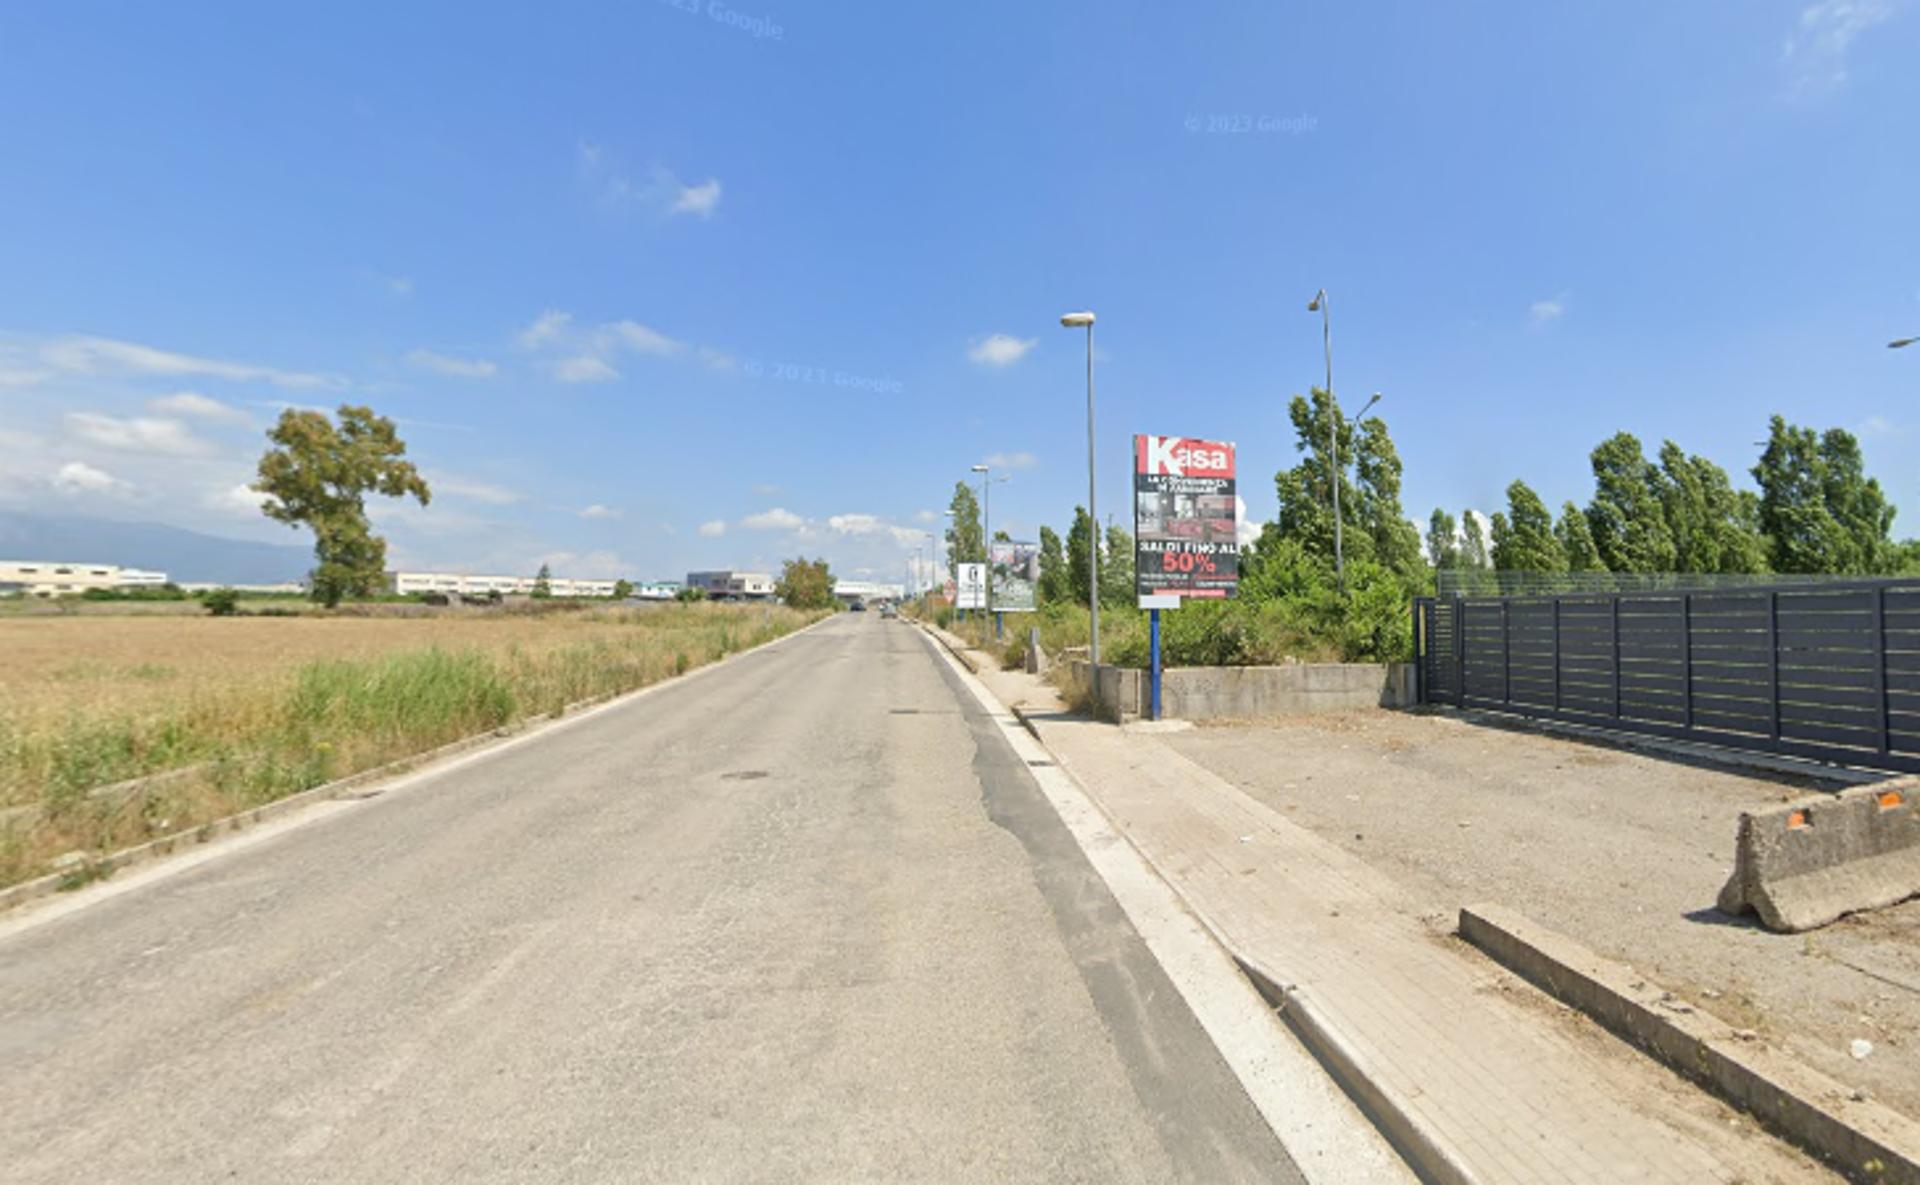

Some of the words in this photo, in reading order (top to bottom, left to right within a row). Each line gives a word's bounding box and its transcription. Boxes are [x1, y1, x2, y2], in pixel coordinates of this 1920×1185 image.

[1147, 436, 1228, 477] Kasa
[1140, 542, 1181, 553] SALDI
[1184, 542, 1216, 554] FINO
[1219, 544, 1236, 554] AL
[1163, 551, 1216, 573] 50%
